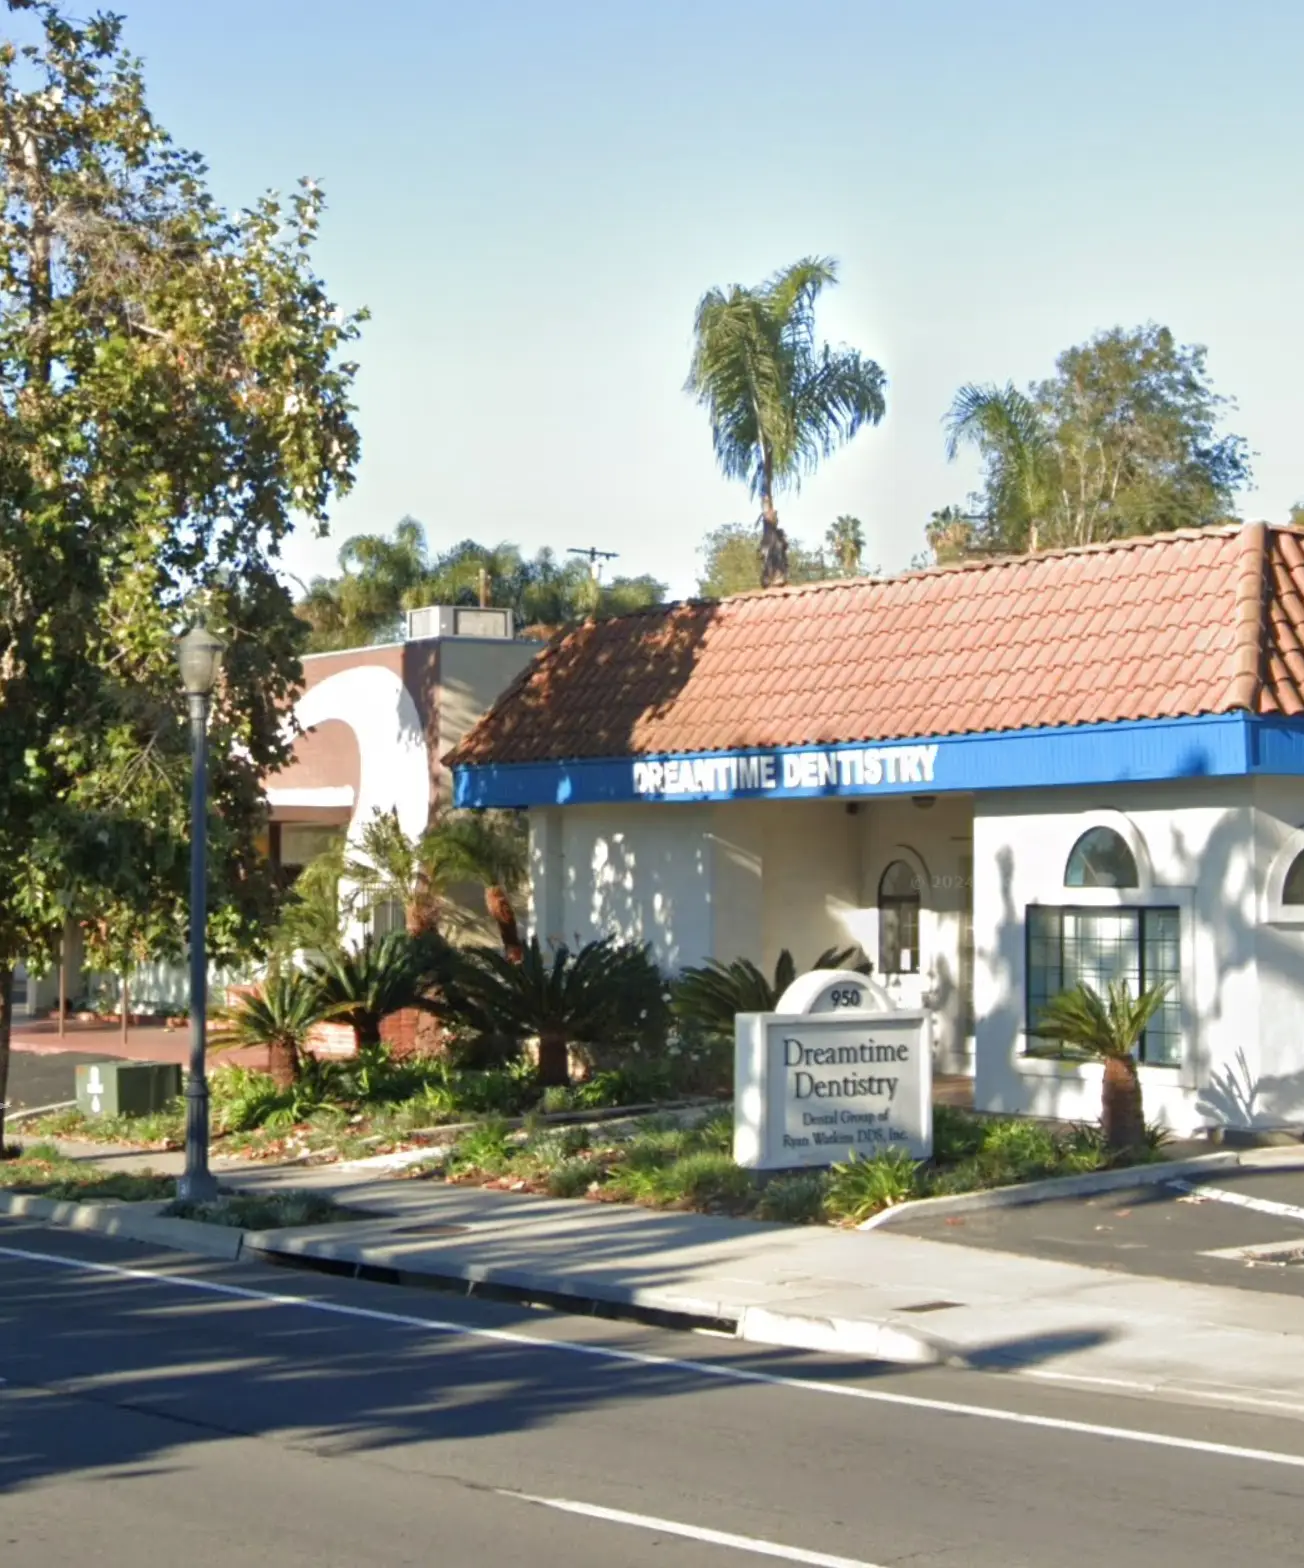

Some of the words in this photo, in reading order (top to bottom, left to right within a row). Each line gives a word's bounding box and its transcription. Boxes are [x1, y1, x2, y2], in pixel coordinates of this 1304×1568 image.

[633, 755, 777, 794] DREAMTIME
[782, 745, 938, 787] DENTISTRY
[831, 988, 861, 1007] 950
[783, 1038, 909, 1067] Dreamtime
[794, 1071, 899, 1101] Dentistry
[802, 1109, 837, 1126] Dental
[840, 1109, 876, 1125] Group
[877, 1107, 891, 1122] of
